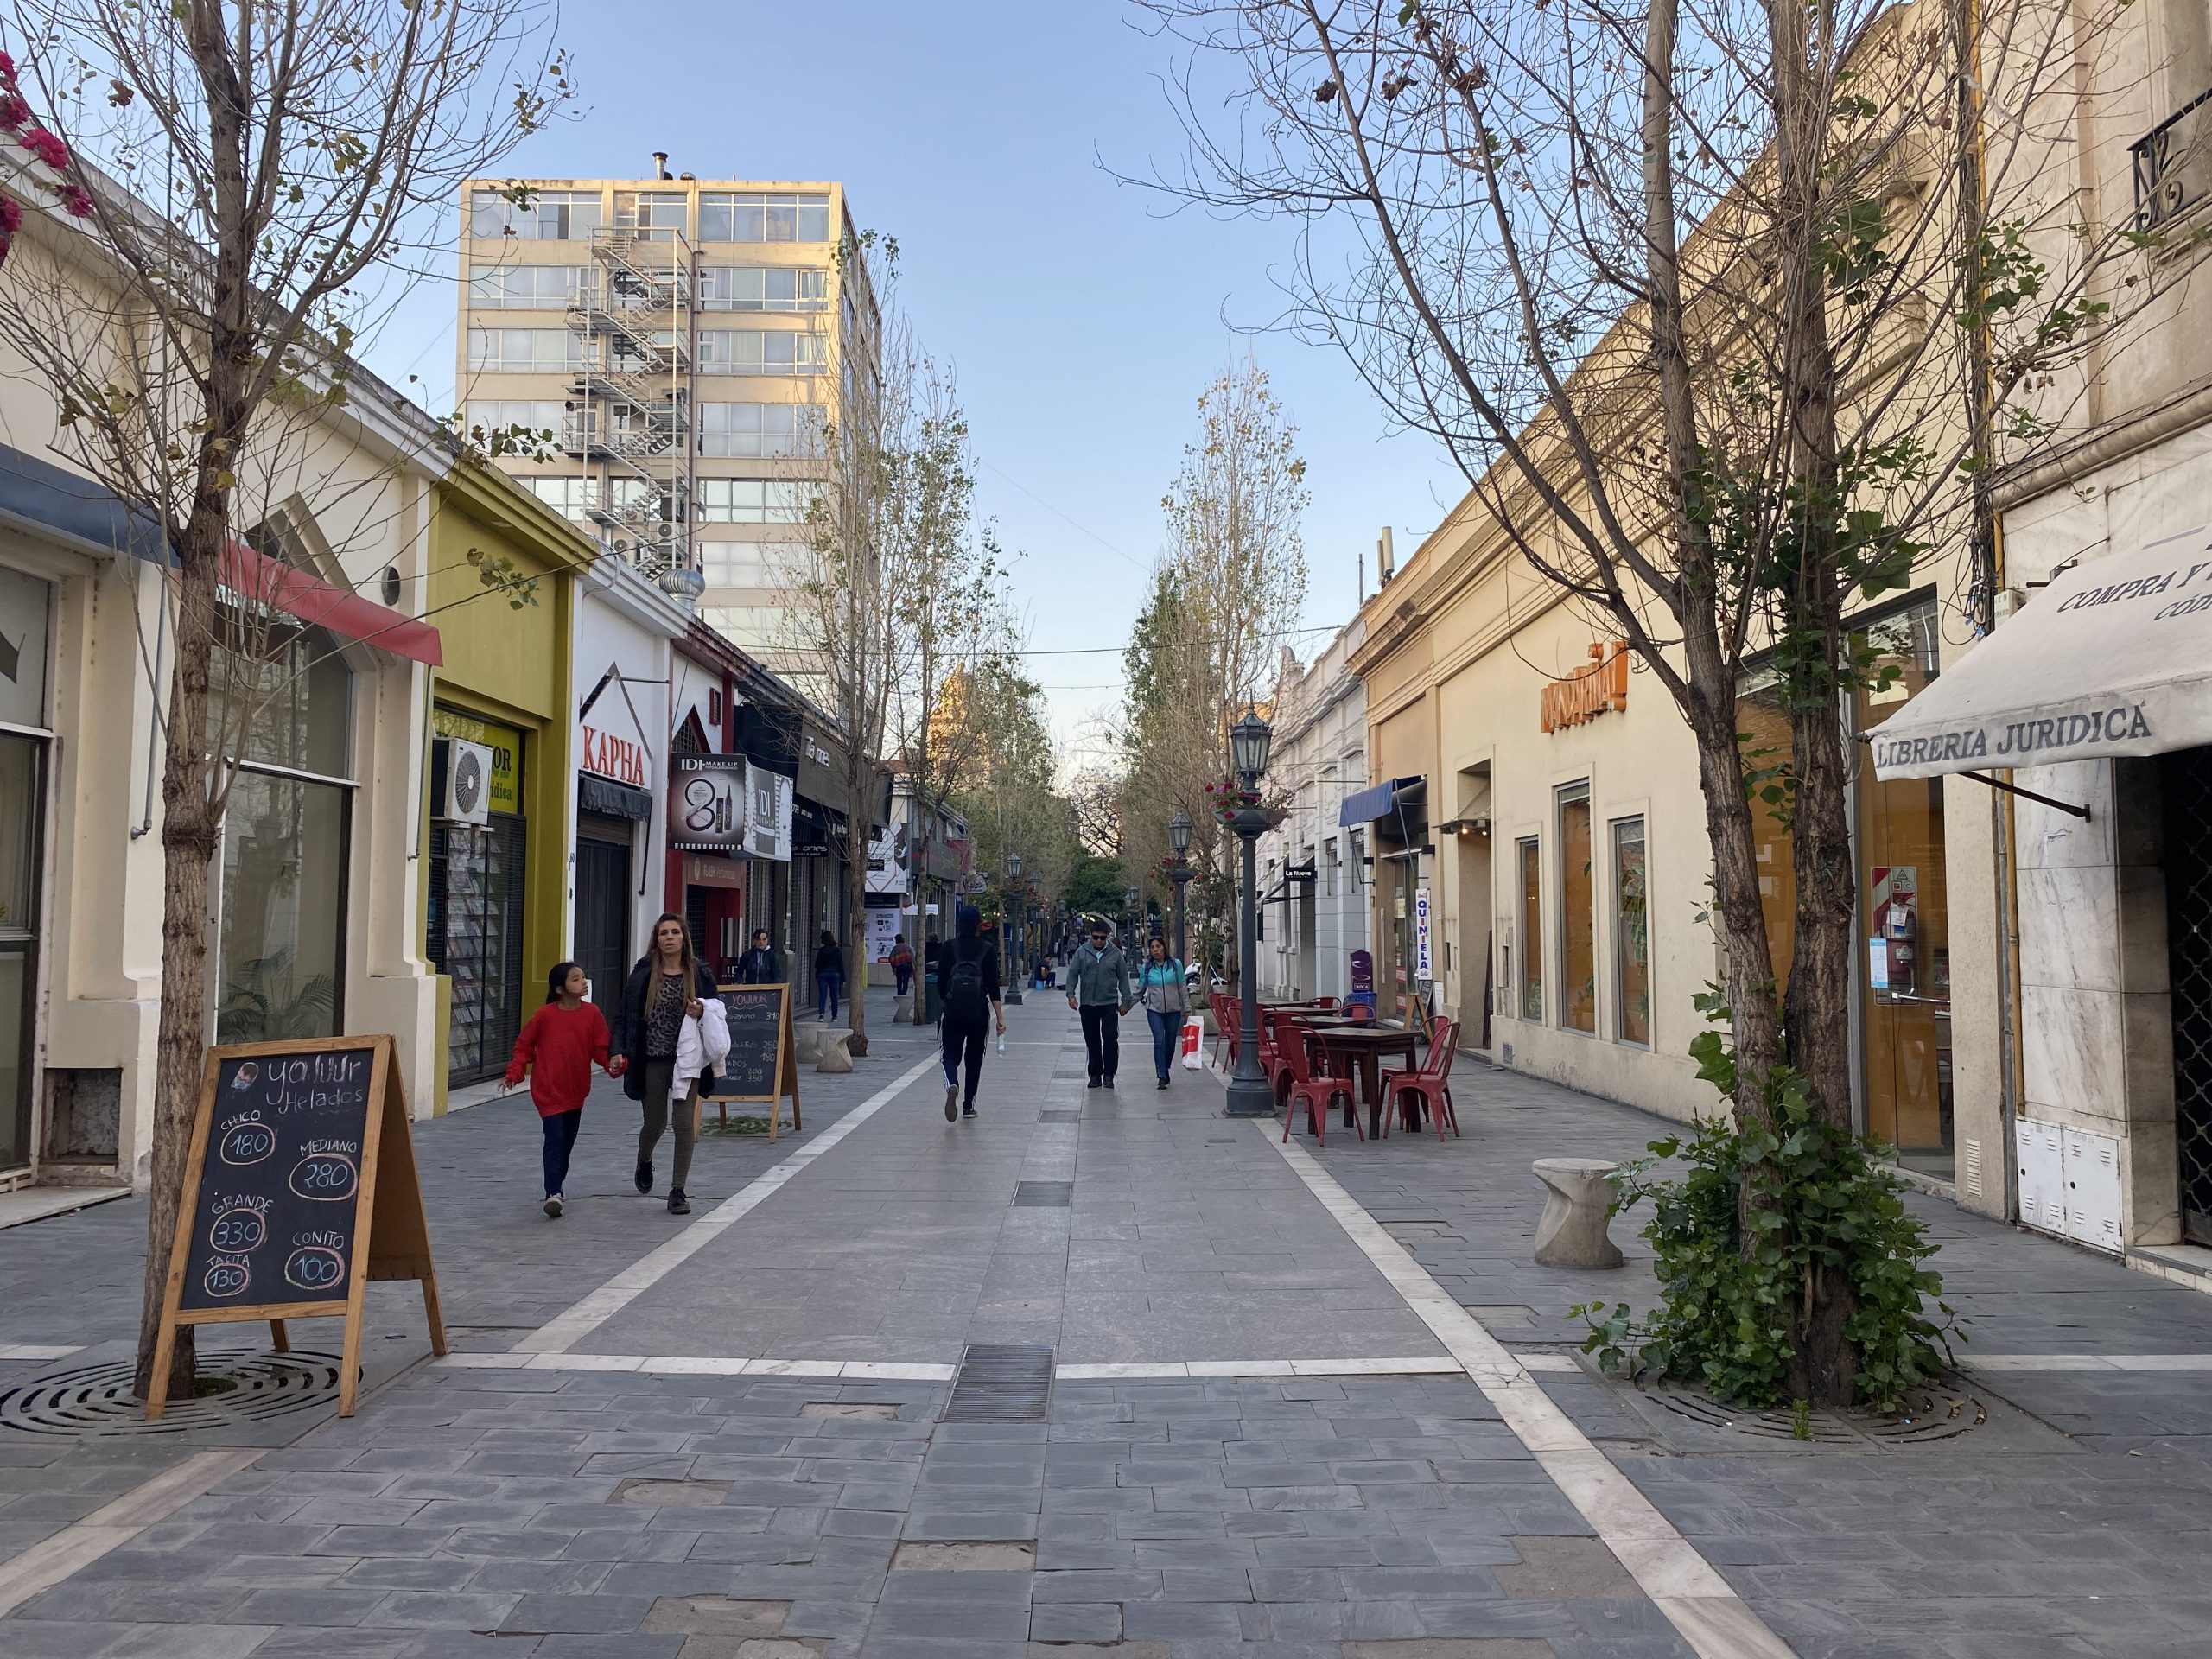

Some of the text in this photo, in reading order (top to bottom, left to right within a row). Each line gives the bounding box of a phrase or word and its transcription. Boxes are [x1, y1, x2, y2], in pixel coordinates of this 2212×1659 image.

[2056, 562, 2212, 613] COMPRA Y
[1875, 704, 2152, 769] LIBRERIA JURIDICA
[583, 725, 645, 785] KAPHA
[681, 759, 702, 771] IDI
[759, 788, 771, 817] IDI
[1418, 900, 1428, 969] QUINIELA
[220, 1109, 261, 1130] CHICO
[229, 1134, 269, 1156] 180
[300, 1139, 358, 1155] MEDIANO
[304, 1164, 348, 1188] 280
[211, 1194, 274, 1215] GRANDE
[215, 1220, 261, 1245] 330
[292, 1230, 345, 1249] CONITO
[205, 1254, 251, 1268] TACITA
[294, 1257, 338, 1281] 100
[209, 1268, 244, 1288] 130
